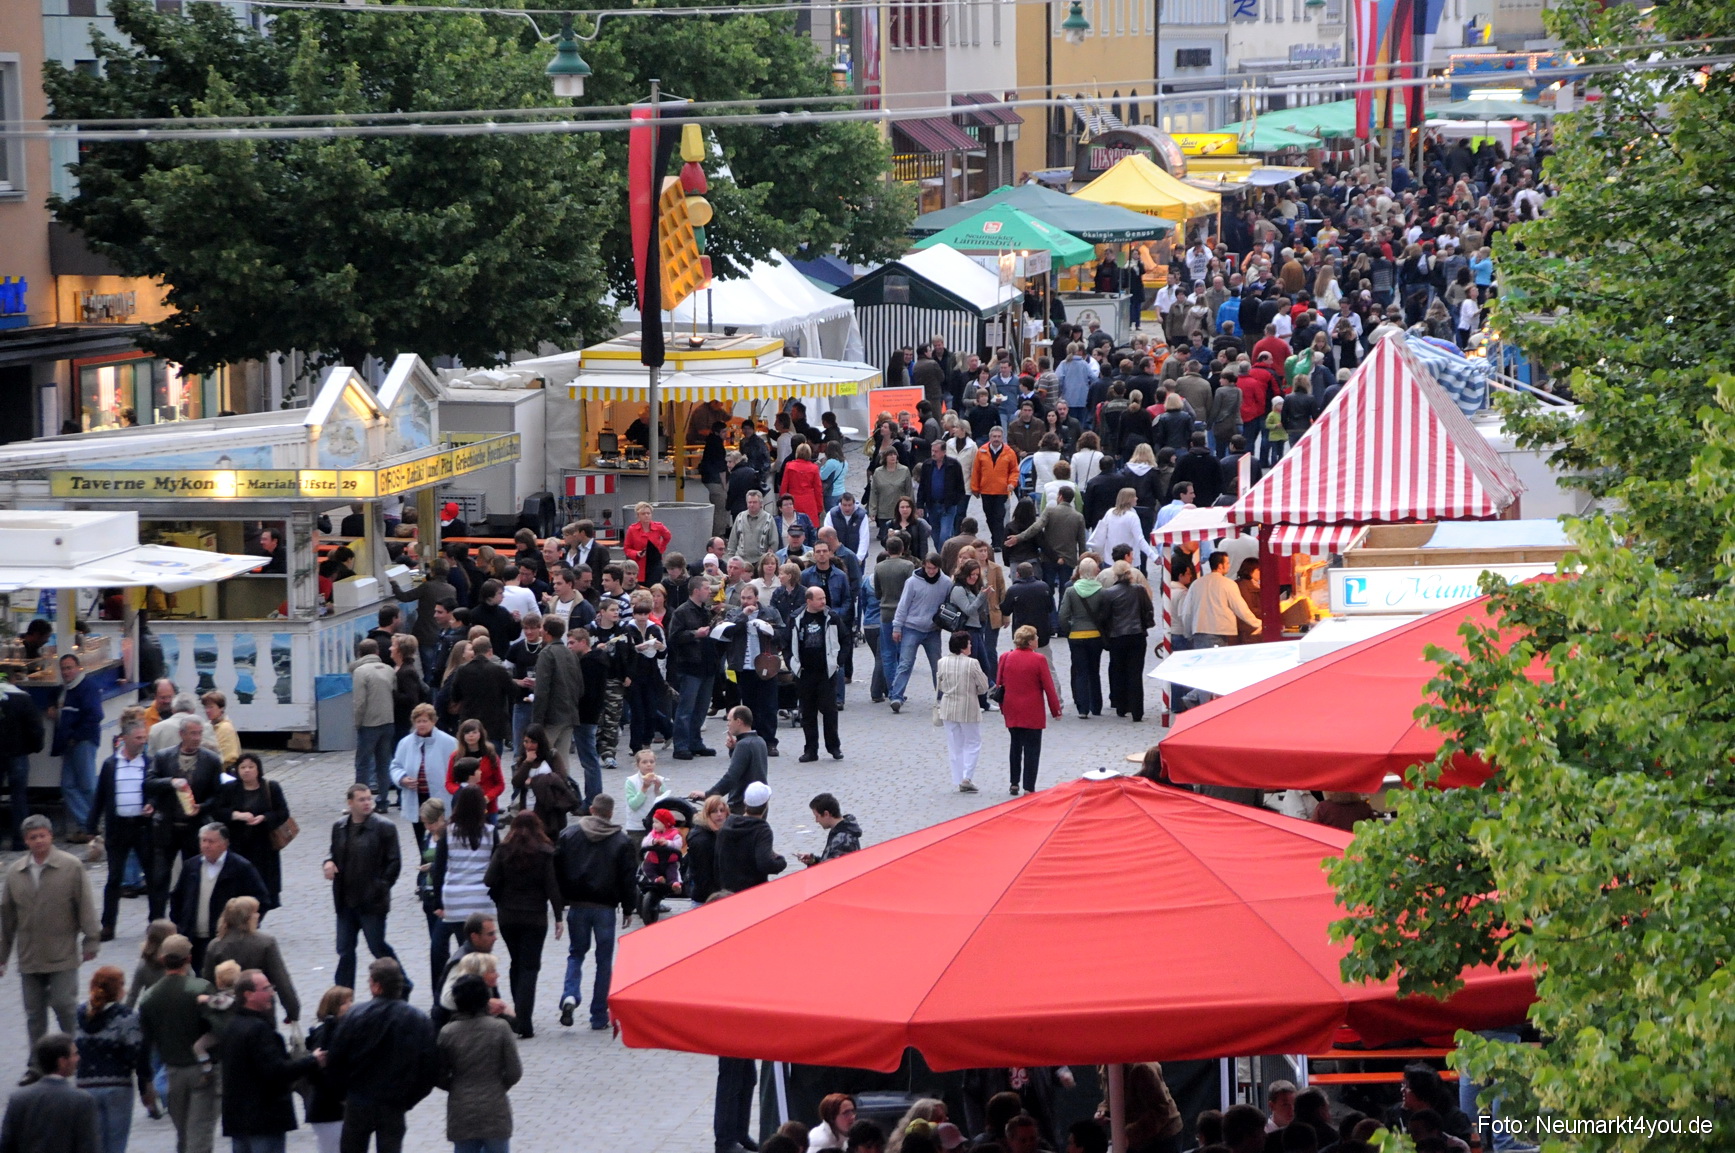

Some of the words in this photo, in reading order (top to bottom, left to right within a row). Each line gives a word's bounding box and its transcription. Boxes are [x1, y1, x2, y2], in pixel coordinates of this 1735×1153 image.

[953, 236, 1022, 248] Lammsbräu
[965, 233, 1015, 241] Neumarkter
[441, 457, 453, 475] Pita
[70, 476, 146, 491] Taverne
[152, 476, 233, 493] Mykon
[247, 478, 337, 491] Mariahilfstr.
[342, 479, 358, 491] 29
